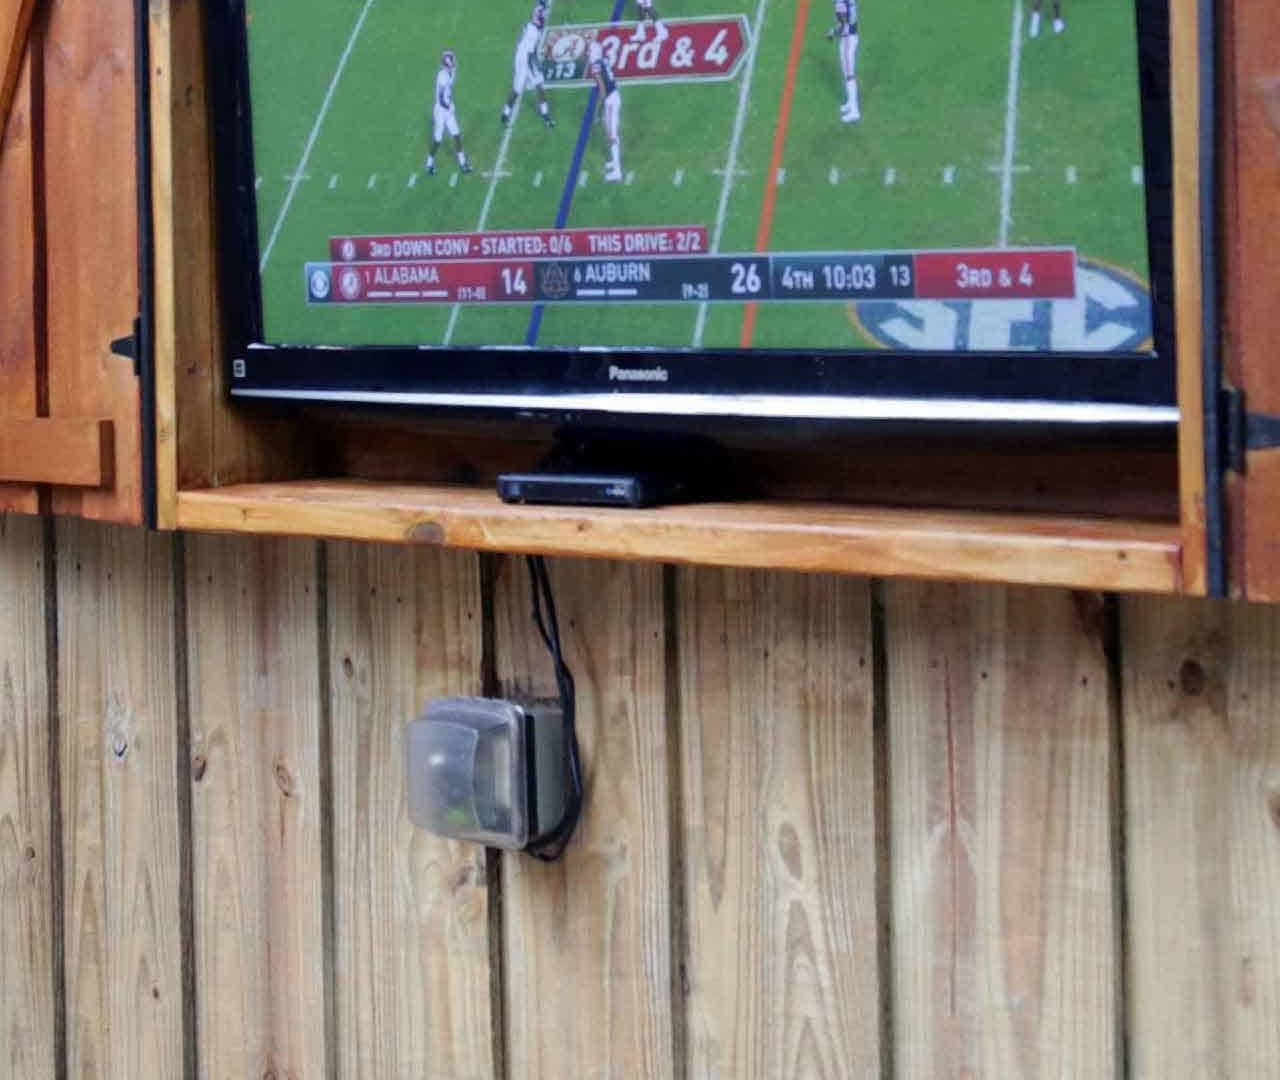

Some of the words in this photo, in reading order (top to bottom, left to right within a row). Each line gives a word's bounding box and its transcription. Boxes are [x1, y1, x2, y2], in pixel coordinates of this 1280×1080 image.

[671, 37, 694, 67] &
[705, 29, 728, 65] 4
[393, 239, 432, 256] DOWN
[434, 237, 470, 255] CONV
[482, 235, 547, 255] STARTED:
[589, 234, 620, 252] THIS
[624, 232, 673, 252] DRIVE:
[677, 231, 701, 251] 2/2
[375, 265, 440, 285] ALABAMA
[501, 267, 527, 295] 14
[585, 263, 651, 282] AUBURN
[730, 263, 761, 293] 26
[822, 264, 876, 289] 10:03
[889, 265, 910, 286] 13
[955, 263, 992, 288] 3RD
[998, 266, 1012, 287] &
[1019, 262, 1033, 287] 4
[608, 365, 668, 381] Panasonic
